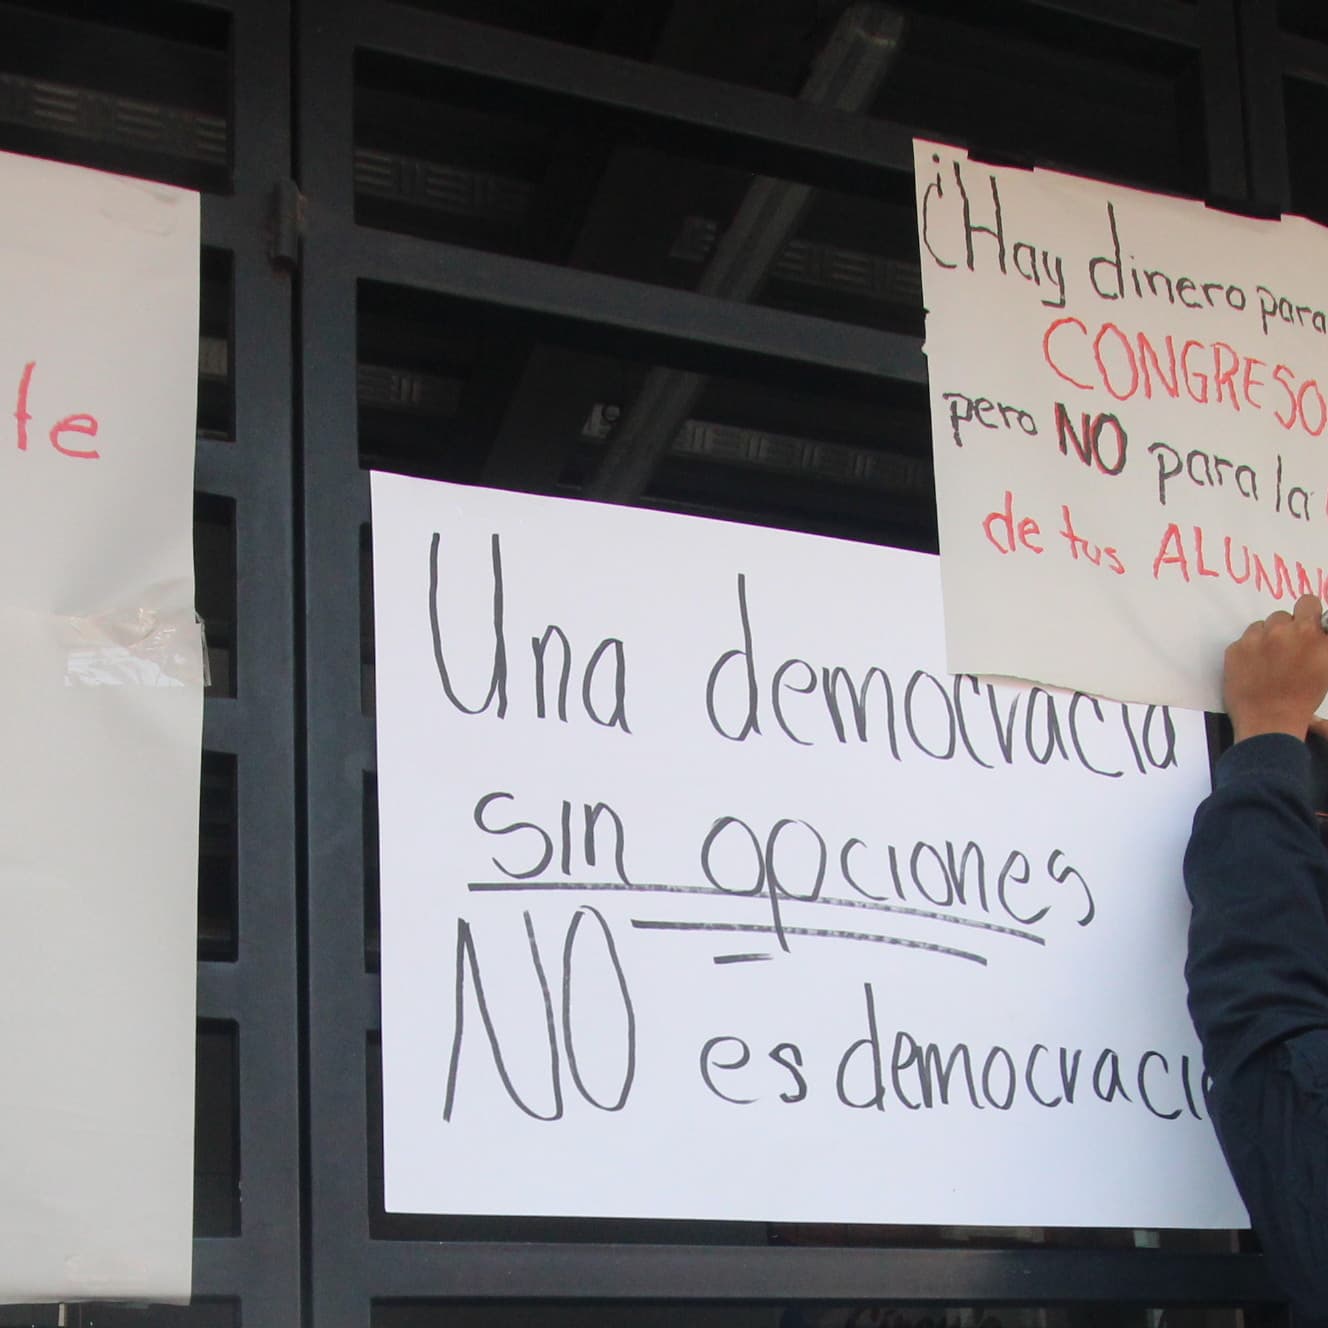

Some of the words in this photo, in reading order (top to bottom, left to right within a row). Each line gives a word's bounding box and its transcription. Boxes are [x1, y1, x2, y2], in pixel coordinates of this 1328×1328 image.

[1088, 201, 1247, 312] dinero
[1255, 285, 1328, 336] para
[1041, 316, 1328, 438] CONGRESO
[942, 391, 1039, 448] pero
[1054, 401, 1129, 476] NO
[1147, 440, 1260, 506] para
[1274, 454, 1313, 521] la
[983, 490, 1045, 556] de
[1058, 504, 1127, 576] tus
[429, 531, 634, 736] Una
[705, 572, 1179, 779] democracia
[472, 790, 635, 887] sin
[700, 815, 1096, 955] opciones
[442, 905, 638, 1124] NO
[699, 1034, 806, 1106] es
